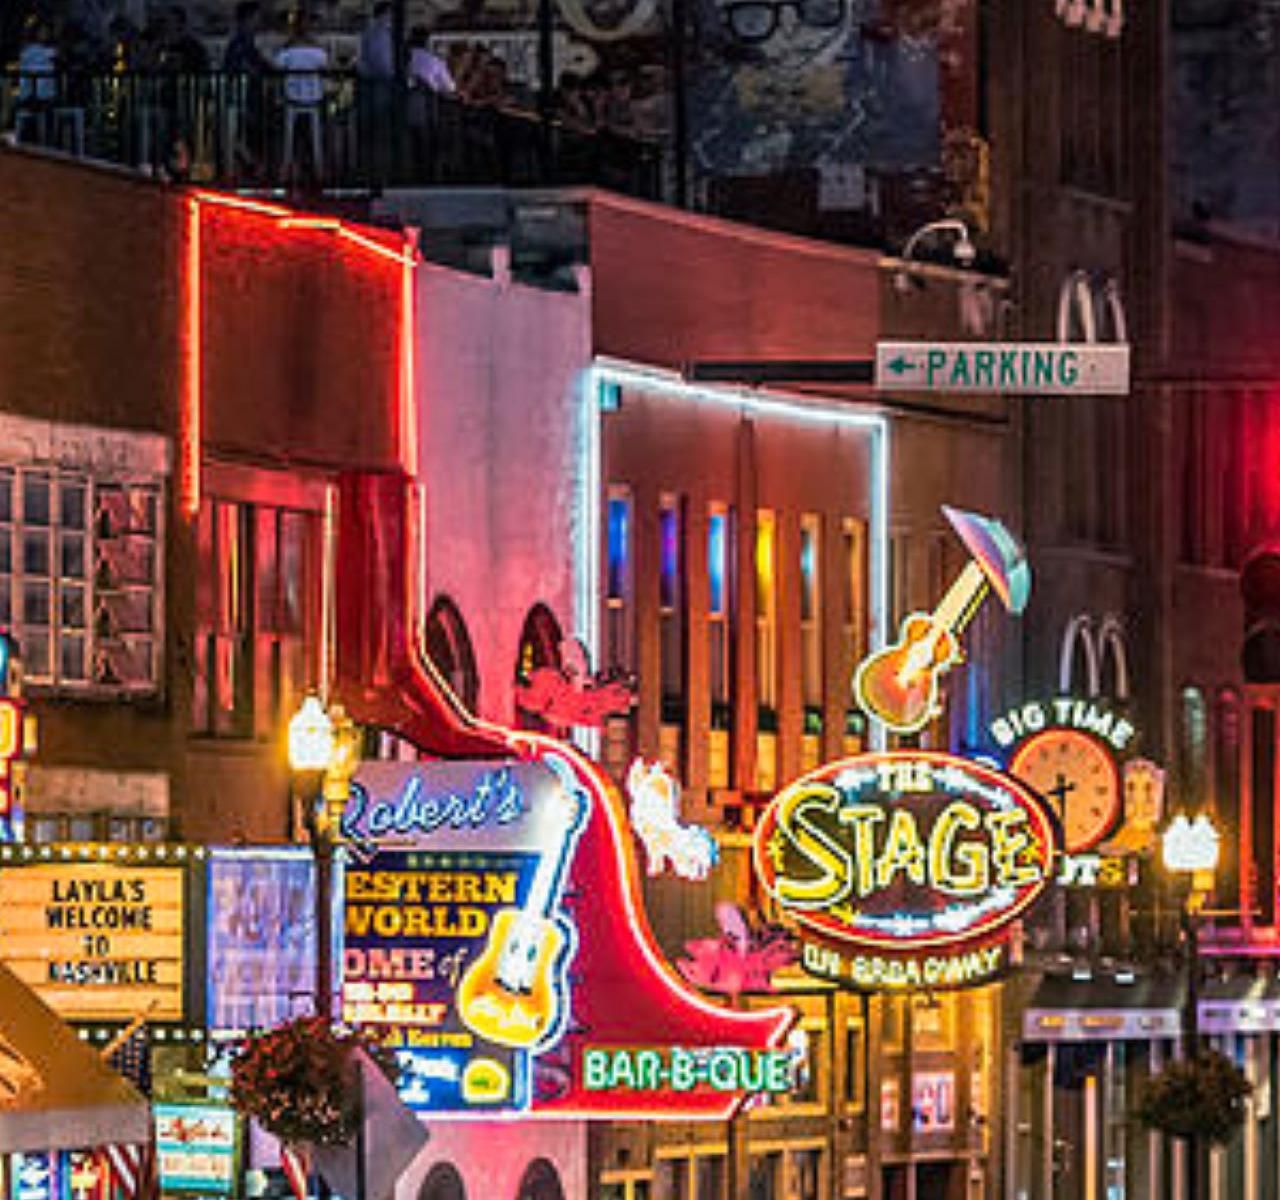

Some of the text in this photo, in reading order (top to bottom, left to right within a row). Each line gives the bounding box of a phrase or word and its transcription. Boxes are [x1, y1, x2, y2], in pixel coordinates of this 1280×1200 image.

[927, 349, 1080, 387] PARKING
[990, 696, 1135, 750] BIG TIME
[877, 761, 934, 793] THE
[773, 782, 1041, 908] STAGE
[51, 879, 146, 903] LAYLA'S
[344, 869, 519, 905] ESTERN
[45, 906, 154, 929] WELCOME
[82, 934, 111, 957] TO
[47, 960, 159, 985] NASHVILLE
[344, 947, 436, 981] OME
[583, 1047, 790, 1091] BAR-B-QUE
